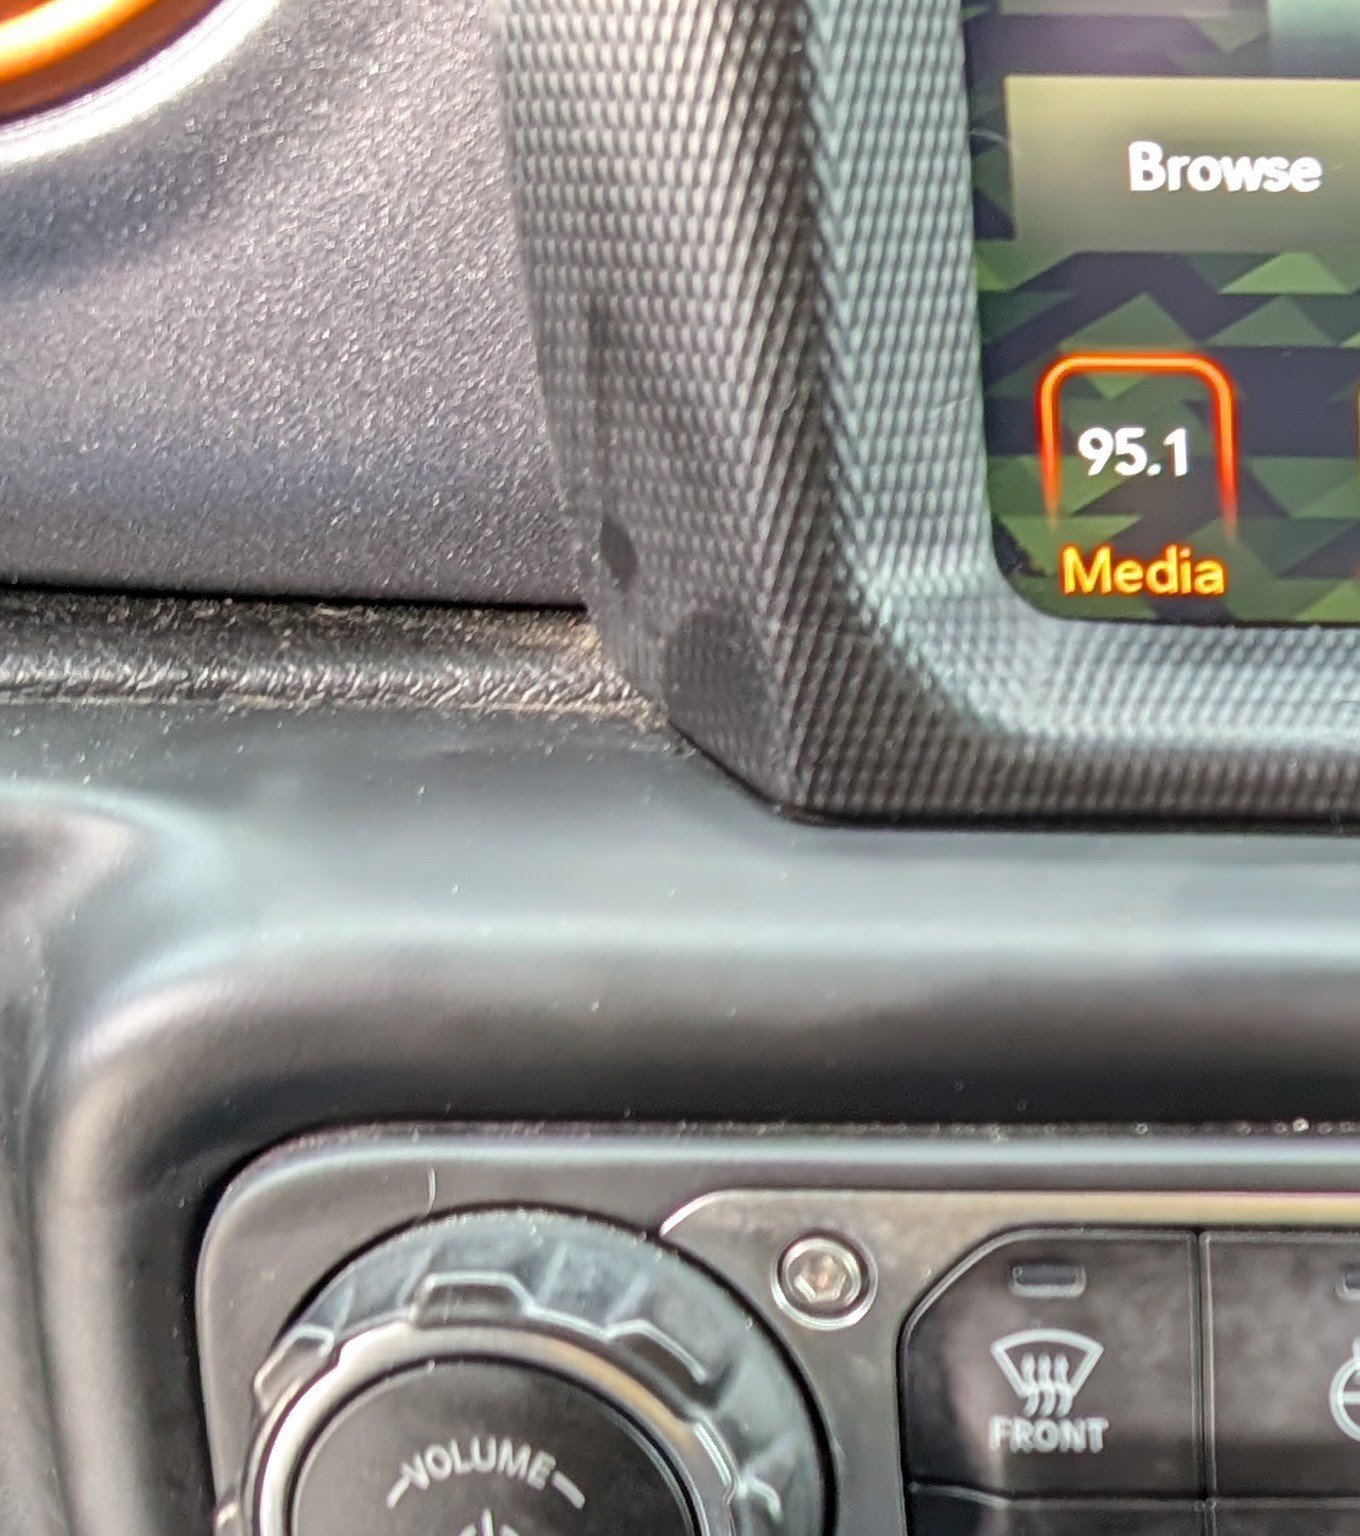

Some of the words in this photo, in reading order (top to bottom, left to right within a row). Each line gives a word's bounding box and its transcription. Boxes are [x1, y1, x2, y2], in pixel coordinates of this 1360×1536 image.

[1128, 143, 1323, 194] Browse
[1077, 427, 1189, 479] 95.1
[1061, 546, 1226, 597] Media
[988, 1414, 1109, 1454] FRONT
[403, 1436, 556, 1490] VOLUME
